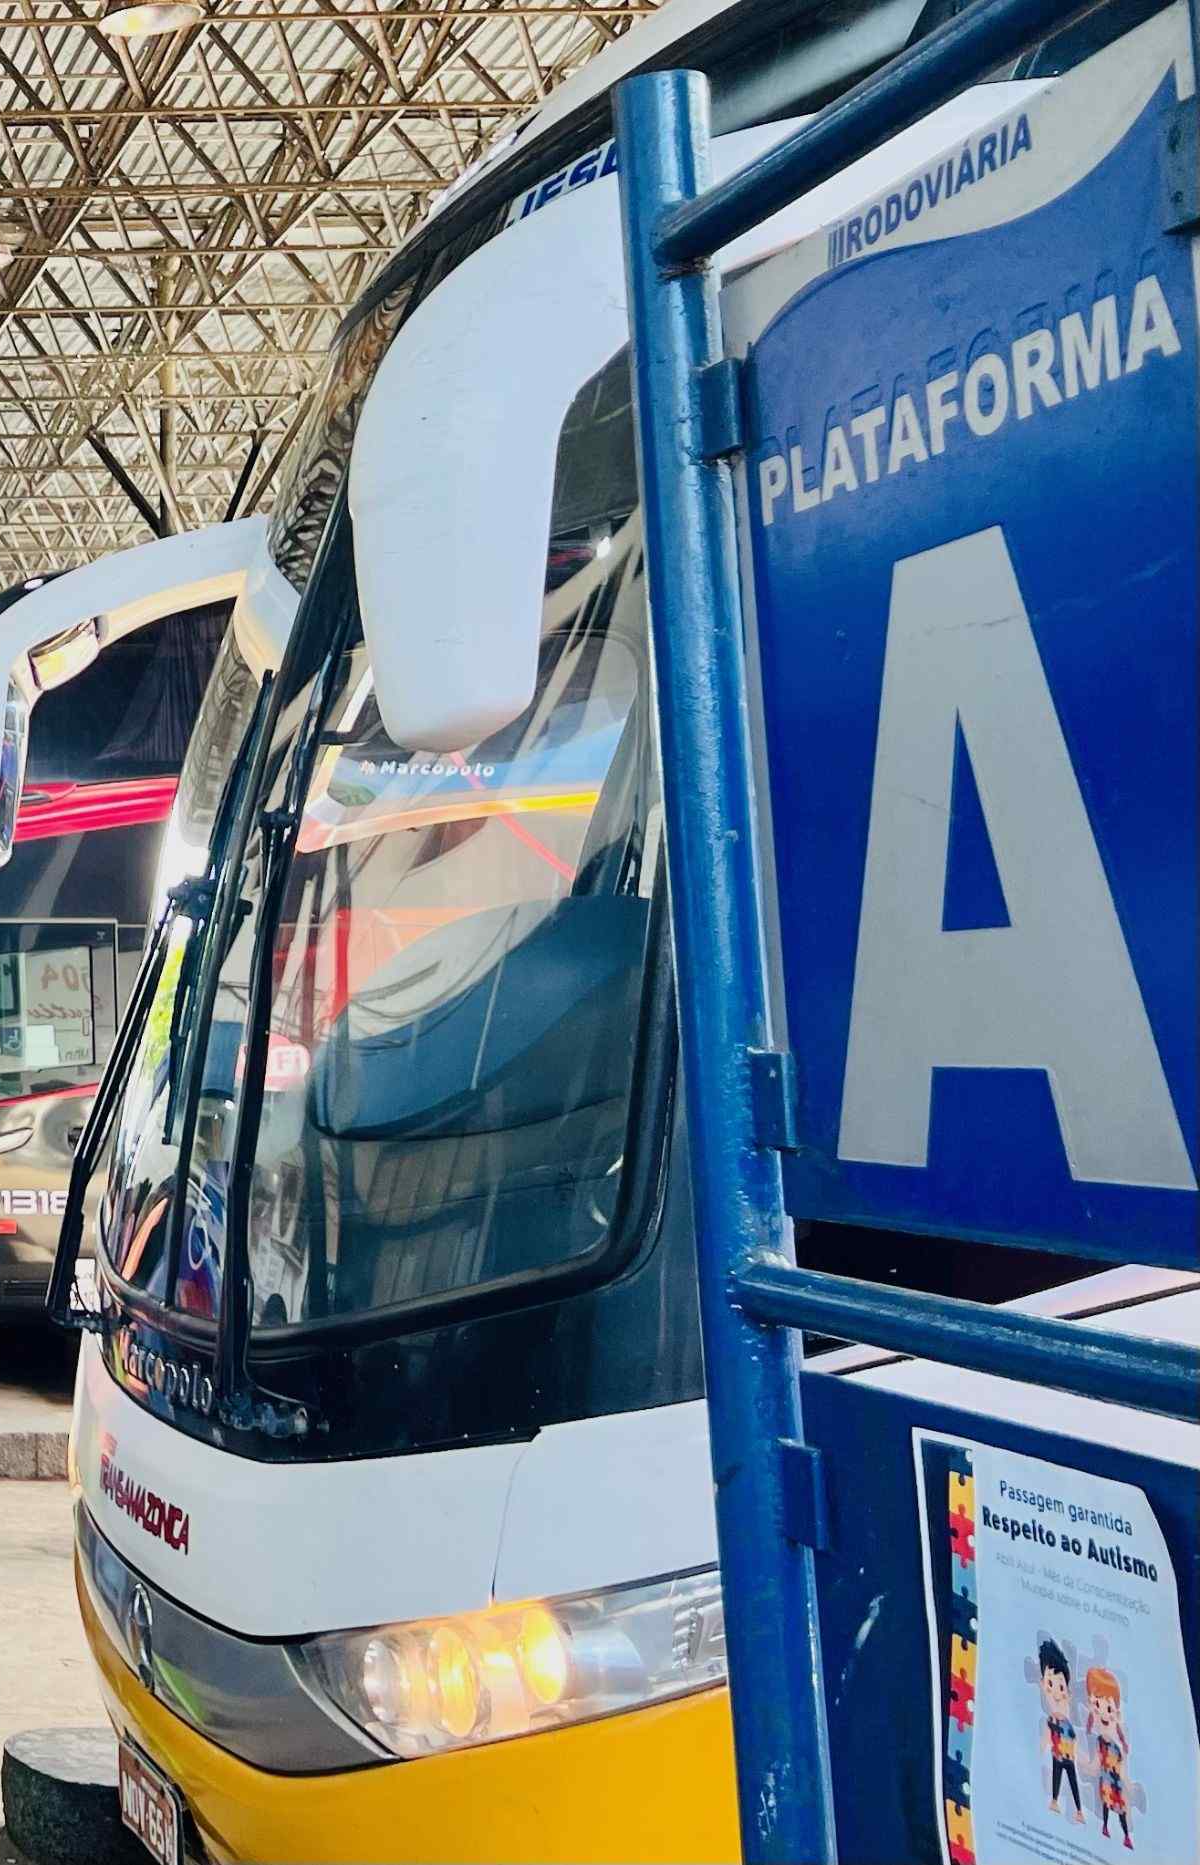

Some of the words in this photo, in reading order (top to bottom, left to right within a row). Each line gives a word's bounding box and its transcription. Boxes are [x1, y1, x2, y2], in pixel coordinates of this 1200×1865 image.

[847, 113, 1032, 255] RODOVIÁRIA
[759, 274, 1181, 526] PLATAFORMA
[380, 760, 496, 777] Marcopolo
[837, 524, 1199, 1191] A
[982, 1505, 1056, 1548] Respeito
[1061, 1534, 1082, 1556] ao
[1088, 1538, 1158, 1583] Autismo
[1000, 1480, 1065, 1513] Passagem
[1068, 1503, 1133, 1536] garantida
